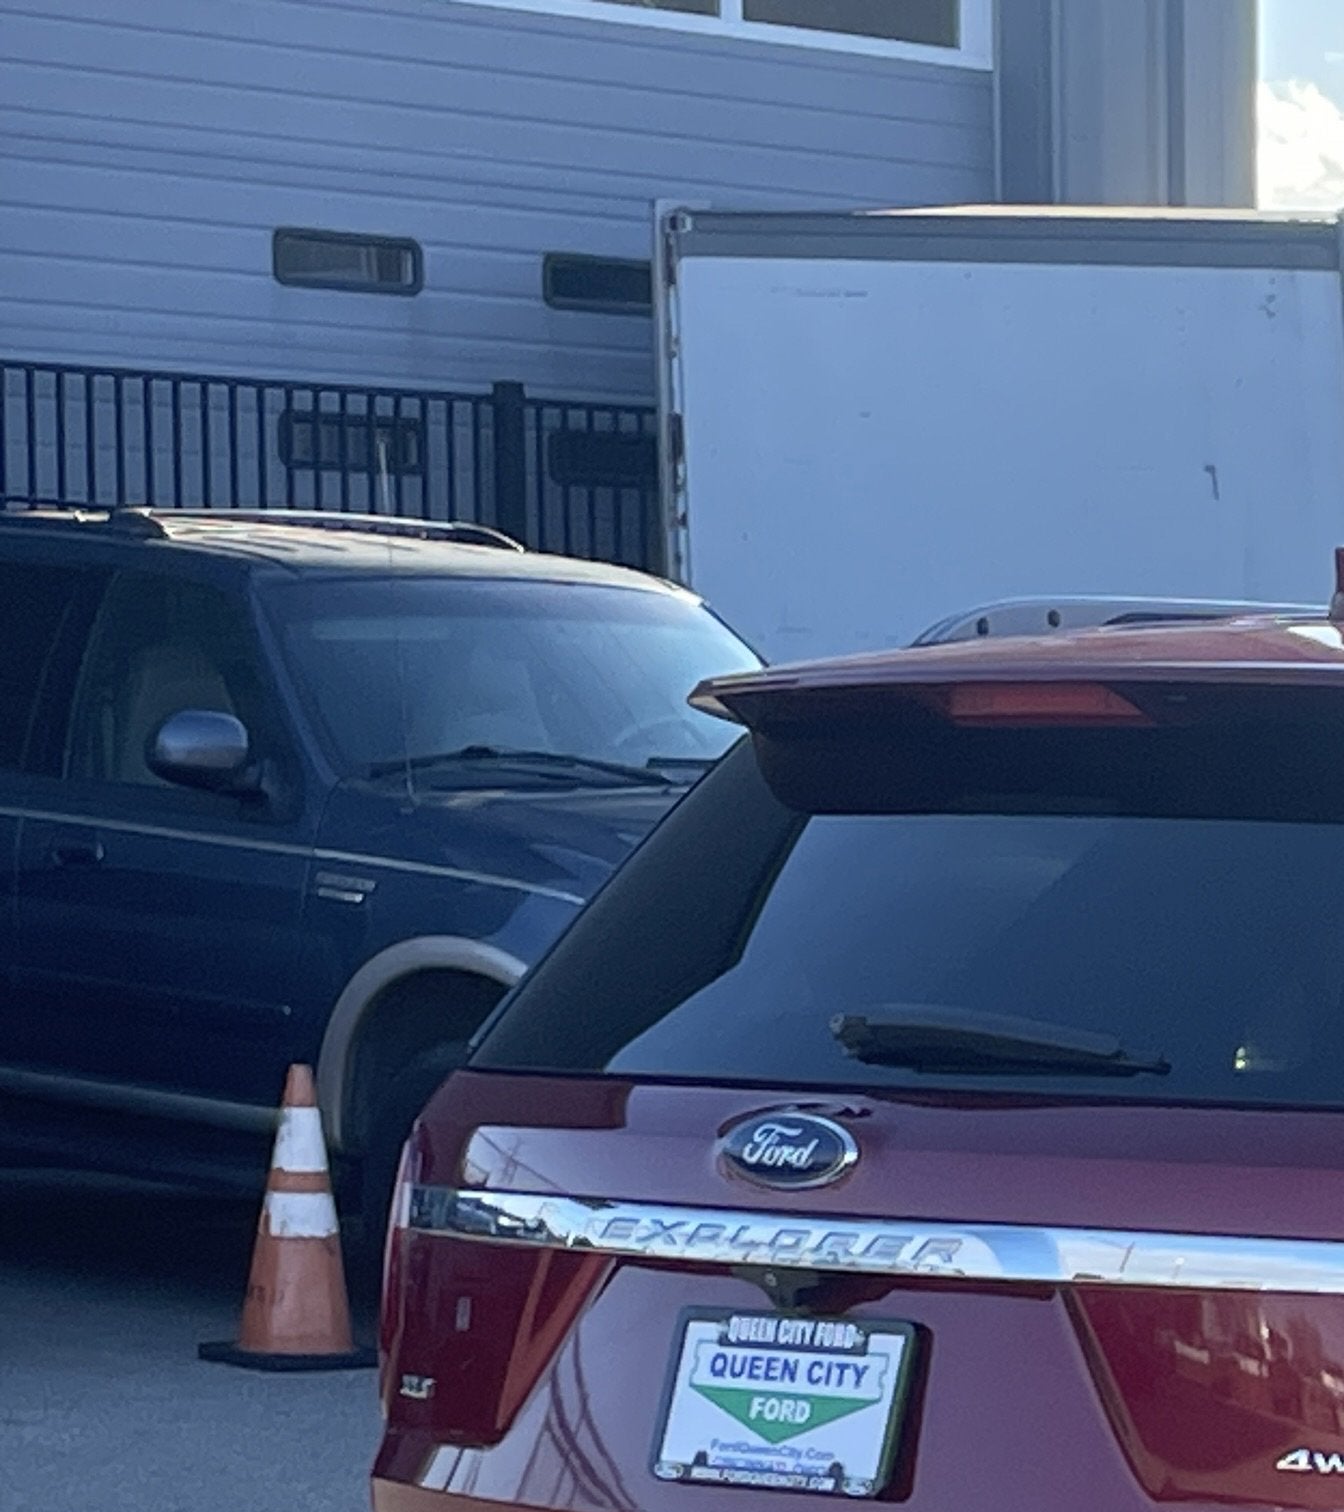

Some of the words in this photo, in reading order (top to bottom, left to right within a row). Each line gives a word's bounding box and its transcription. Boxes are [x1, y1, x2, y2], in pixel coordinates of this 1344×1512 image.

[743, 1122, 818, 1170] Ford
[601, 1215, 964, 1264] EXPLORER
[727, 1316, 778, 1343] QUEEN
[777, 1319, 816, 1346] CITY
[813, 1322, 858, 1349] FORD
[710, 1352, 800, 1383] QUEEN
[806, 1360, 870, 1389] CITY
[749, 1396, 812, 1425] FORD
